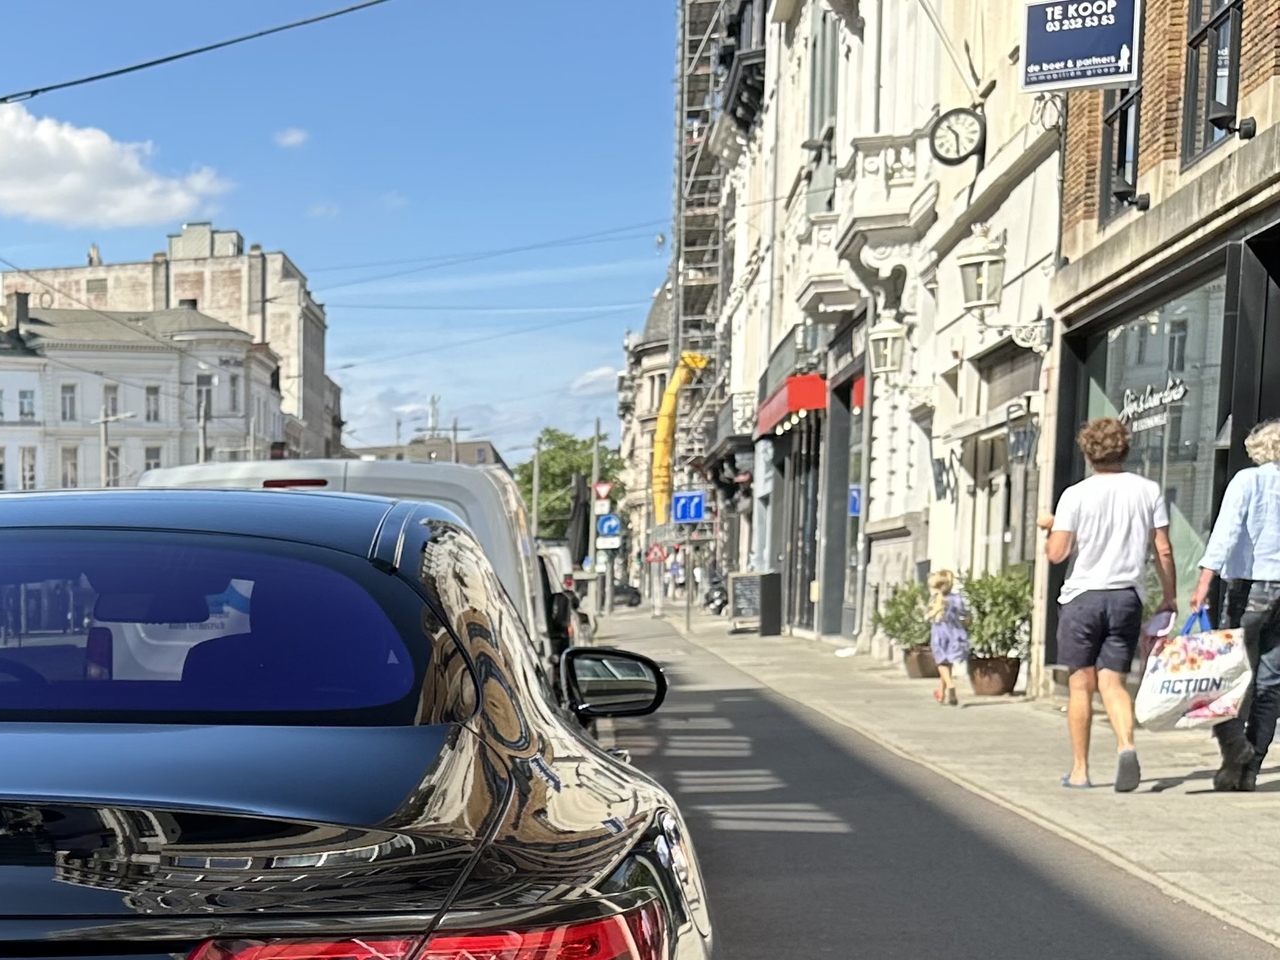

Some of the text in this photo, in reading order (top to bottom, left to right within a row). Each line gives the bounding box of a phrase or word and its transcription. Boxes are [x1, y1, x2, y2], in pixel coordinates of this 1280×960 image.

[1045, 0, 1117, 21] TE KOOP
[1045, 14, 1116, 32] 03 232 53 53
[1067, 59, 1074, 68] &
[1076, 55, 1116, 69] partners
[1159, 677, 1223, 694] ACTION
